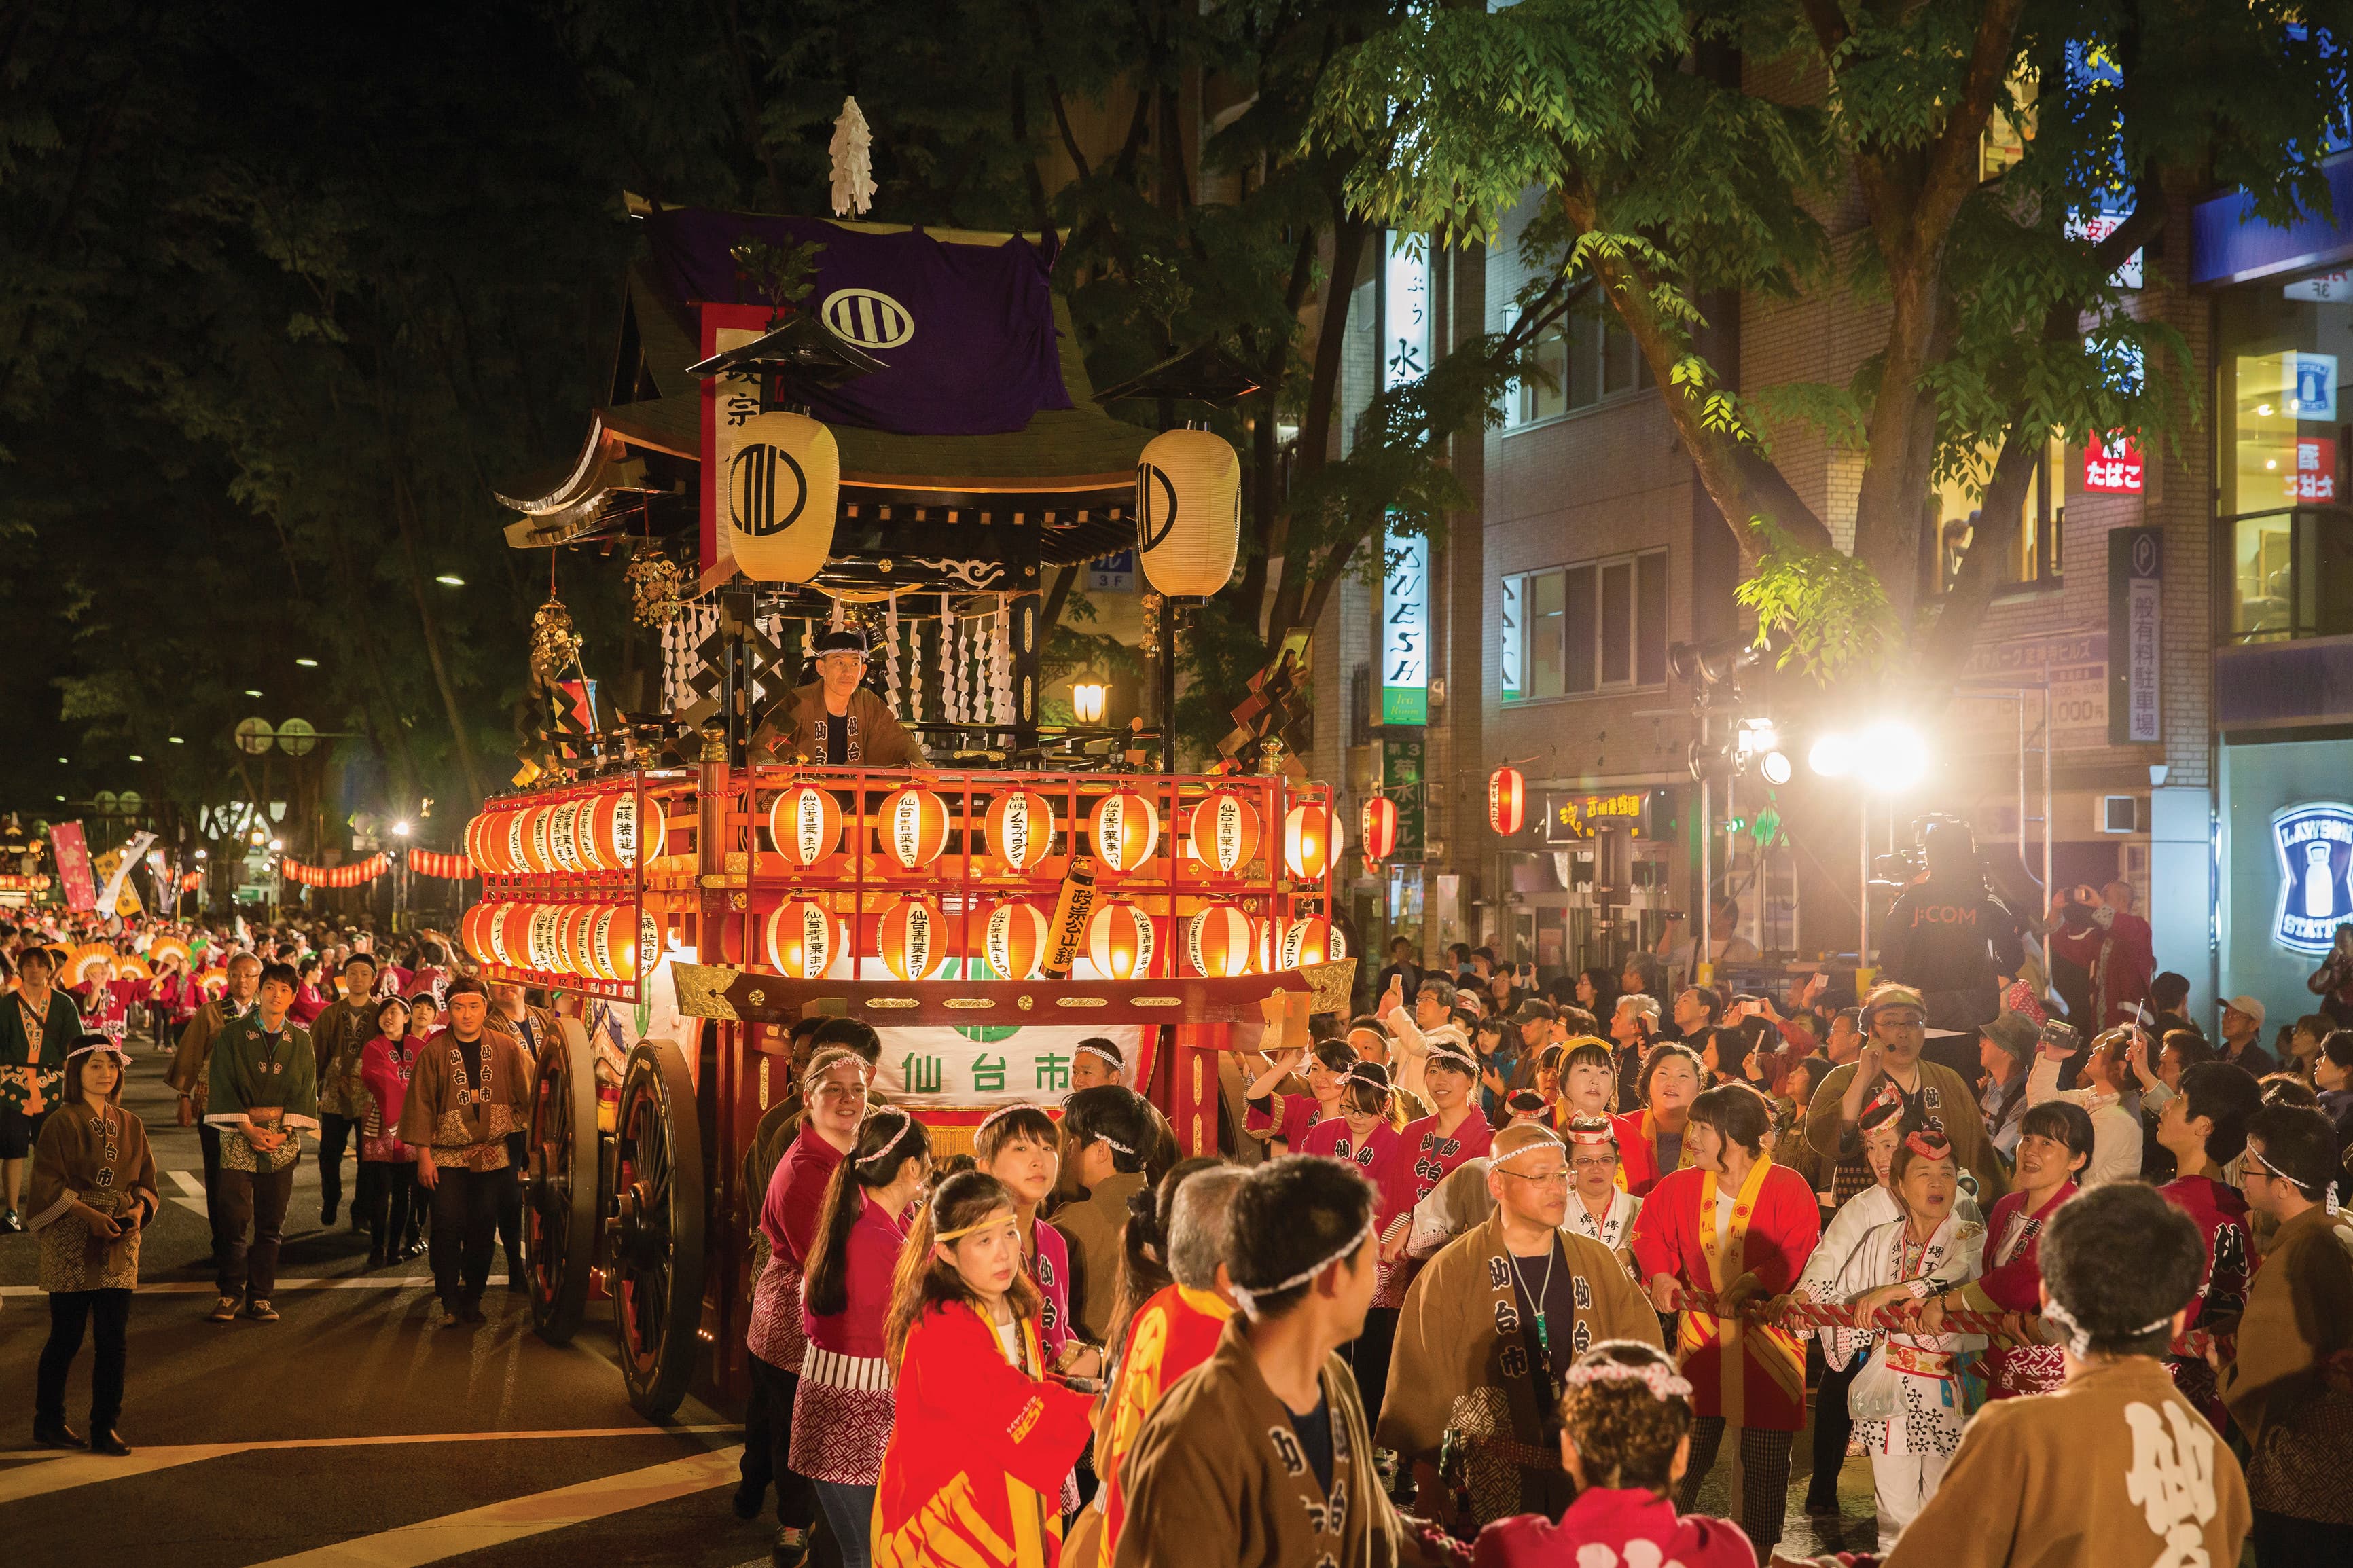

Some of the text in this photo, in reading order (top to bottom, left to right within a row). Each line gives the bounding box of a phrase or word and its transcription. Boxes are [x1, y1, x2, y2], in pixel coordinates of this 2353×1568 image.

[2087, 461, 2141, 488] たばこ
[2134, 584, 2155, 737] 一般有料駐車場
[802, 795, 819, 862] 仙台青葉まつり
[899, 797, 916, 864] 仙台青葉まつり
[1103, 801, 1120, 867] 仙台青葉まつり
[1220, 803, 1237, 869] 仙台青葉まつり
[2281, 819, 2353, 848] LAWSON
[803, 911, 825, 977] 仙台青葉まつり
[910, 910, 929, 977] 仙台青葉まつり
[990, 911, 1011, 978] 仙台青葉まつり
[1053, 888, 1094, 966] 政宗公山鉾
[1911, 904, 1977, 928] J:COM
[449, 1049, 471, 1105] 仙台市
[480, 1044, 493, 1102] 仙台市
[901, 1052, 1071, 1093] 仙台市
[96, 1118, 118, 1188] 仙台市
[1488, 1256, 1528, 1378] 仙台市
[1010, 1396, 1045, 1444] BEST
